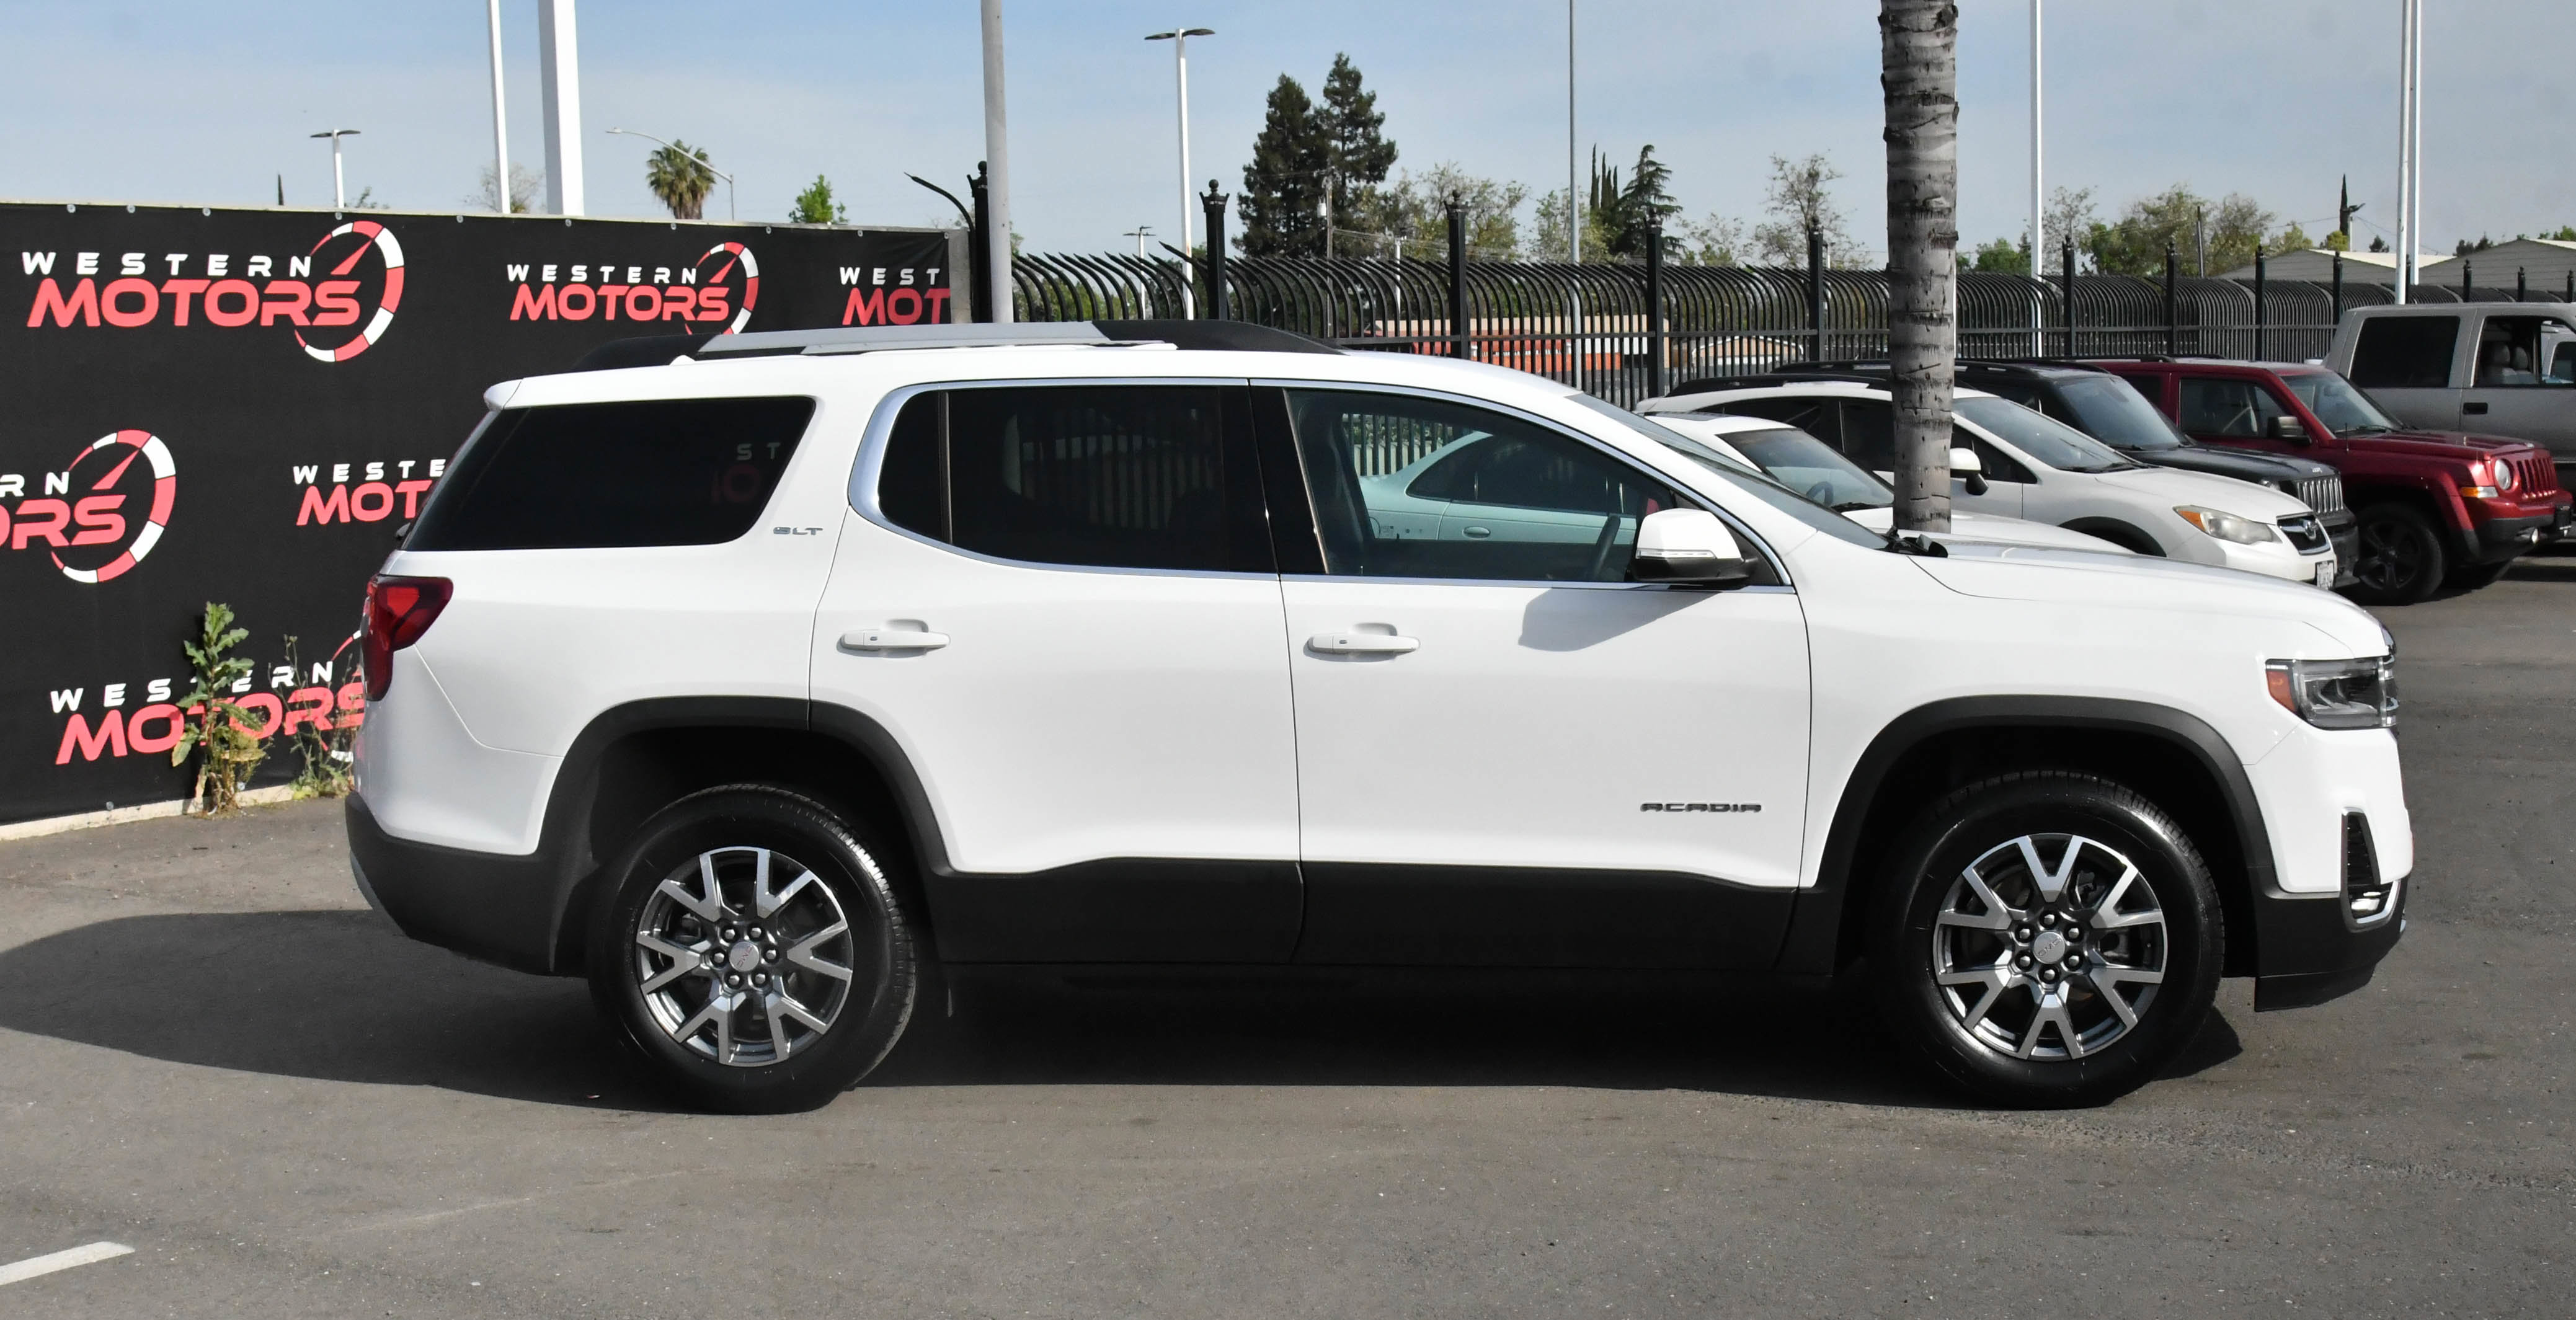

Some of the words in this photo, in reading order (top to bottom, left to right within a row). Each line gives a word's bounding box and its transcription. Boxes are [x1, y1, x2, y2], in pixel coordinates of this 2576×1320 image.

[22, 251, 311, 278] WESTERN
[506, 264, 696, 284] WESTERN
[839, 267, 940, 285] WEST
[26, 277, 362, 328] MOTORS
[509, 283, 730, 321] MOTORS
[842, 287, 951, 326] MOT
[293, 459, 446, 485] WESTE
[296, 479, 432, 526] MOT
[50, 660, 333, 714] WESERN
[1640, 803, 1762, 812] ACADIA
